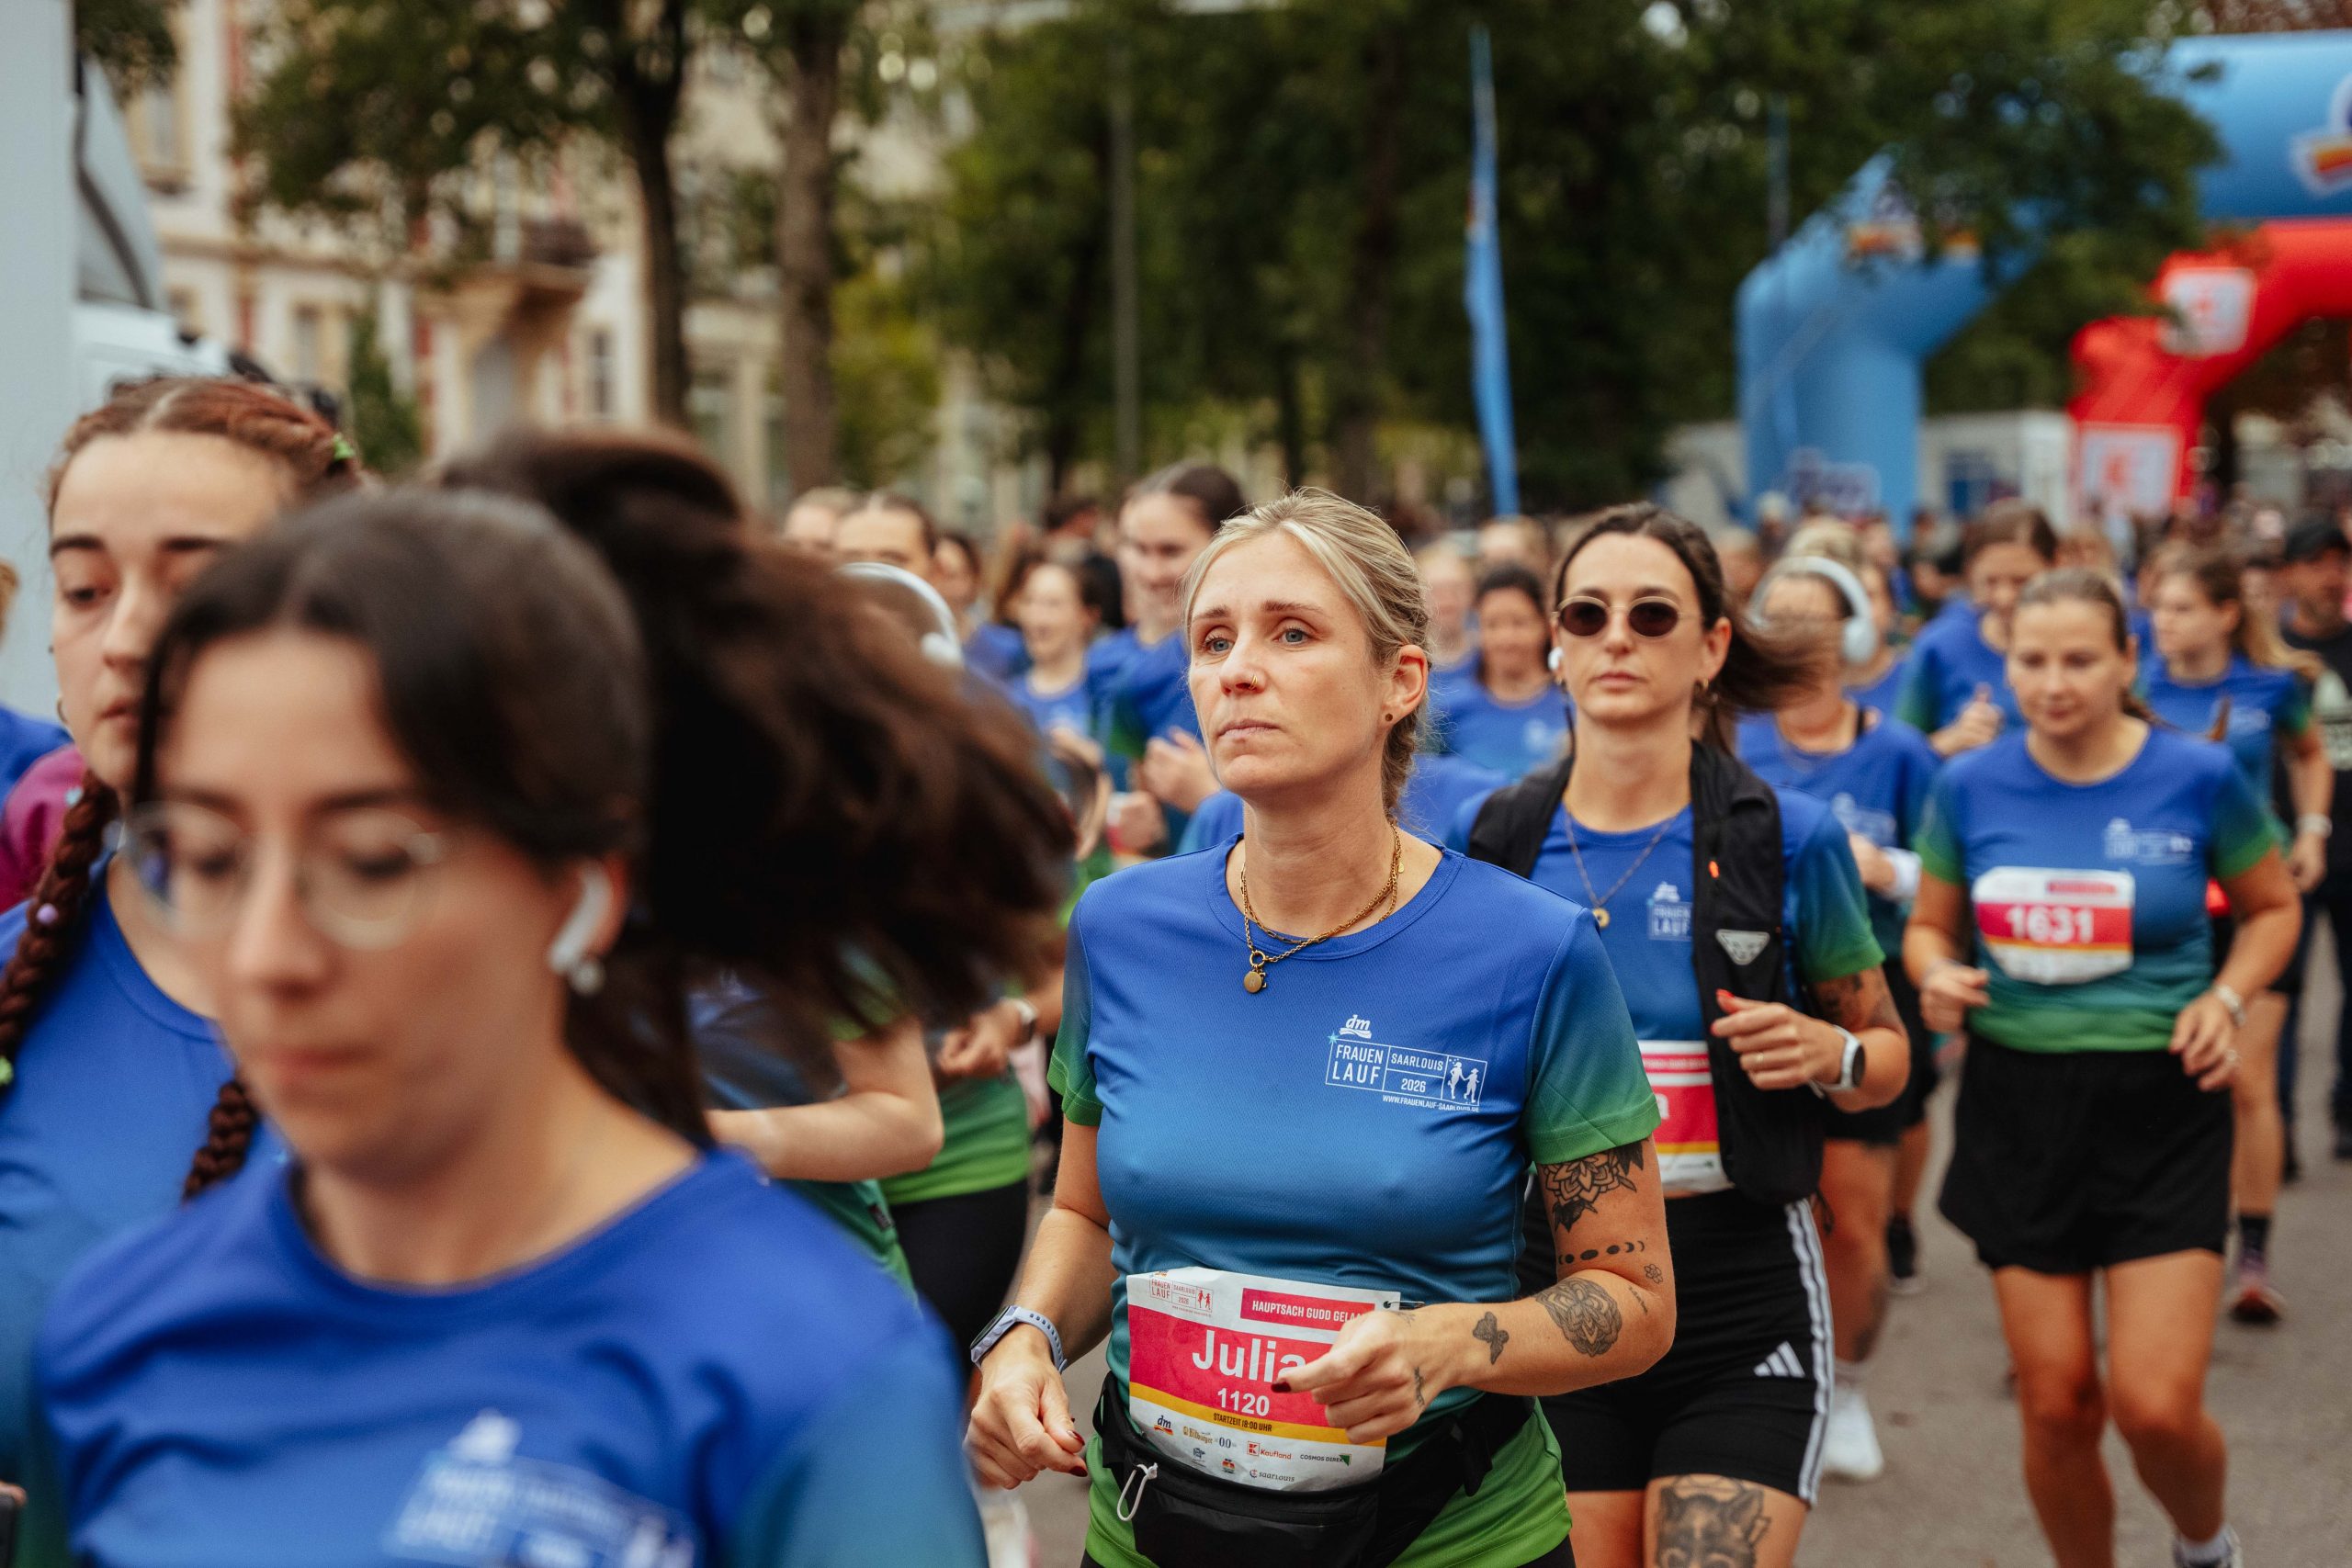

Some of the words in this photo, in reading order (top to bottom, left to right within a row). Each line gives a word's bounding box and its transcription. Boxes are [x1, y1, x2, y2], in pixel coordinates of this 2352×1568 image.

[2005, 905, 2095, 944] 1631
[1345, 1014, 1371, 1031] dm
[1336, 1044, 1384, 1065] FRAUEN
[1391, 1053, 1443, 1071] SAARLOUIS
[1332, 1061, 1381, 1085] LAUF
[1400, 1077, 1427, 1093] 2026
[1151, 1286, 1170, 1299] LAUF
[1252, 1300, 1305, 1317] HAUPTSACH
[1306, 1309, 1331, 1321] GUDD
[1217, 1387, 1270, 1416] 1120
[1157, 1415, 1171, 1429] dm
[1213, 1412, 1242, 1427] STARTZEIT
[1241, 1419, 1258, 1430] 18:00
[1259, 1423, 1272, 1432] UHR
[1261, 1449, 1292, 1460] Kaufland
